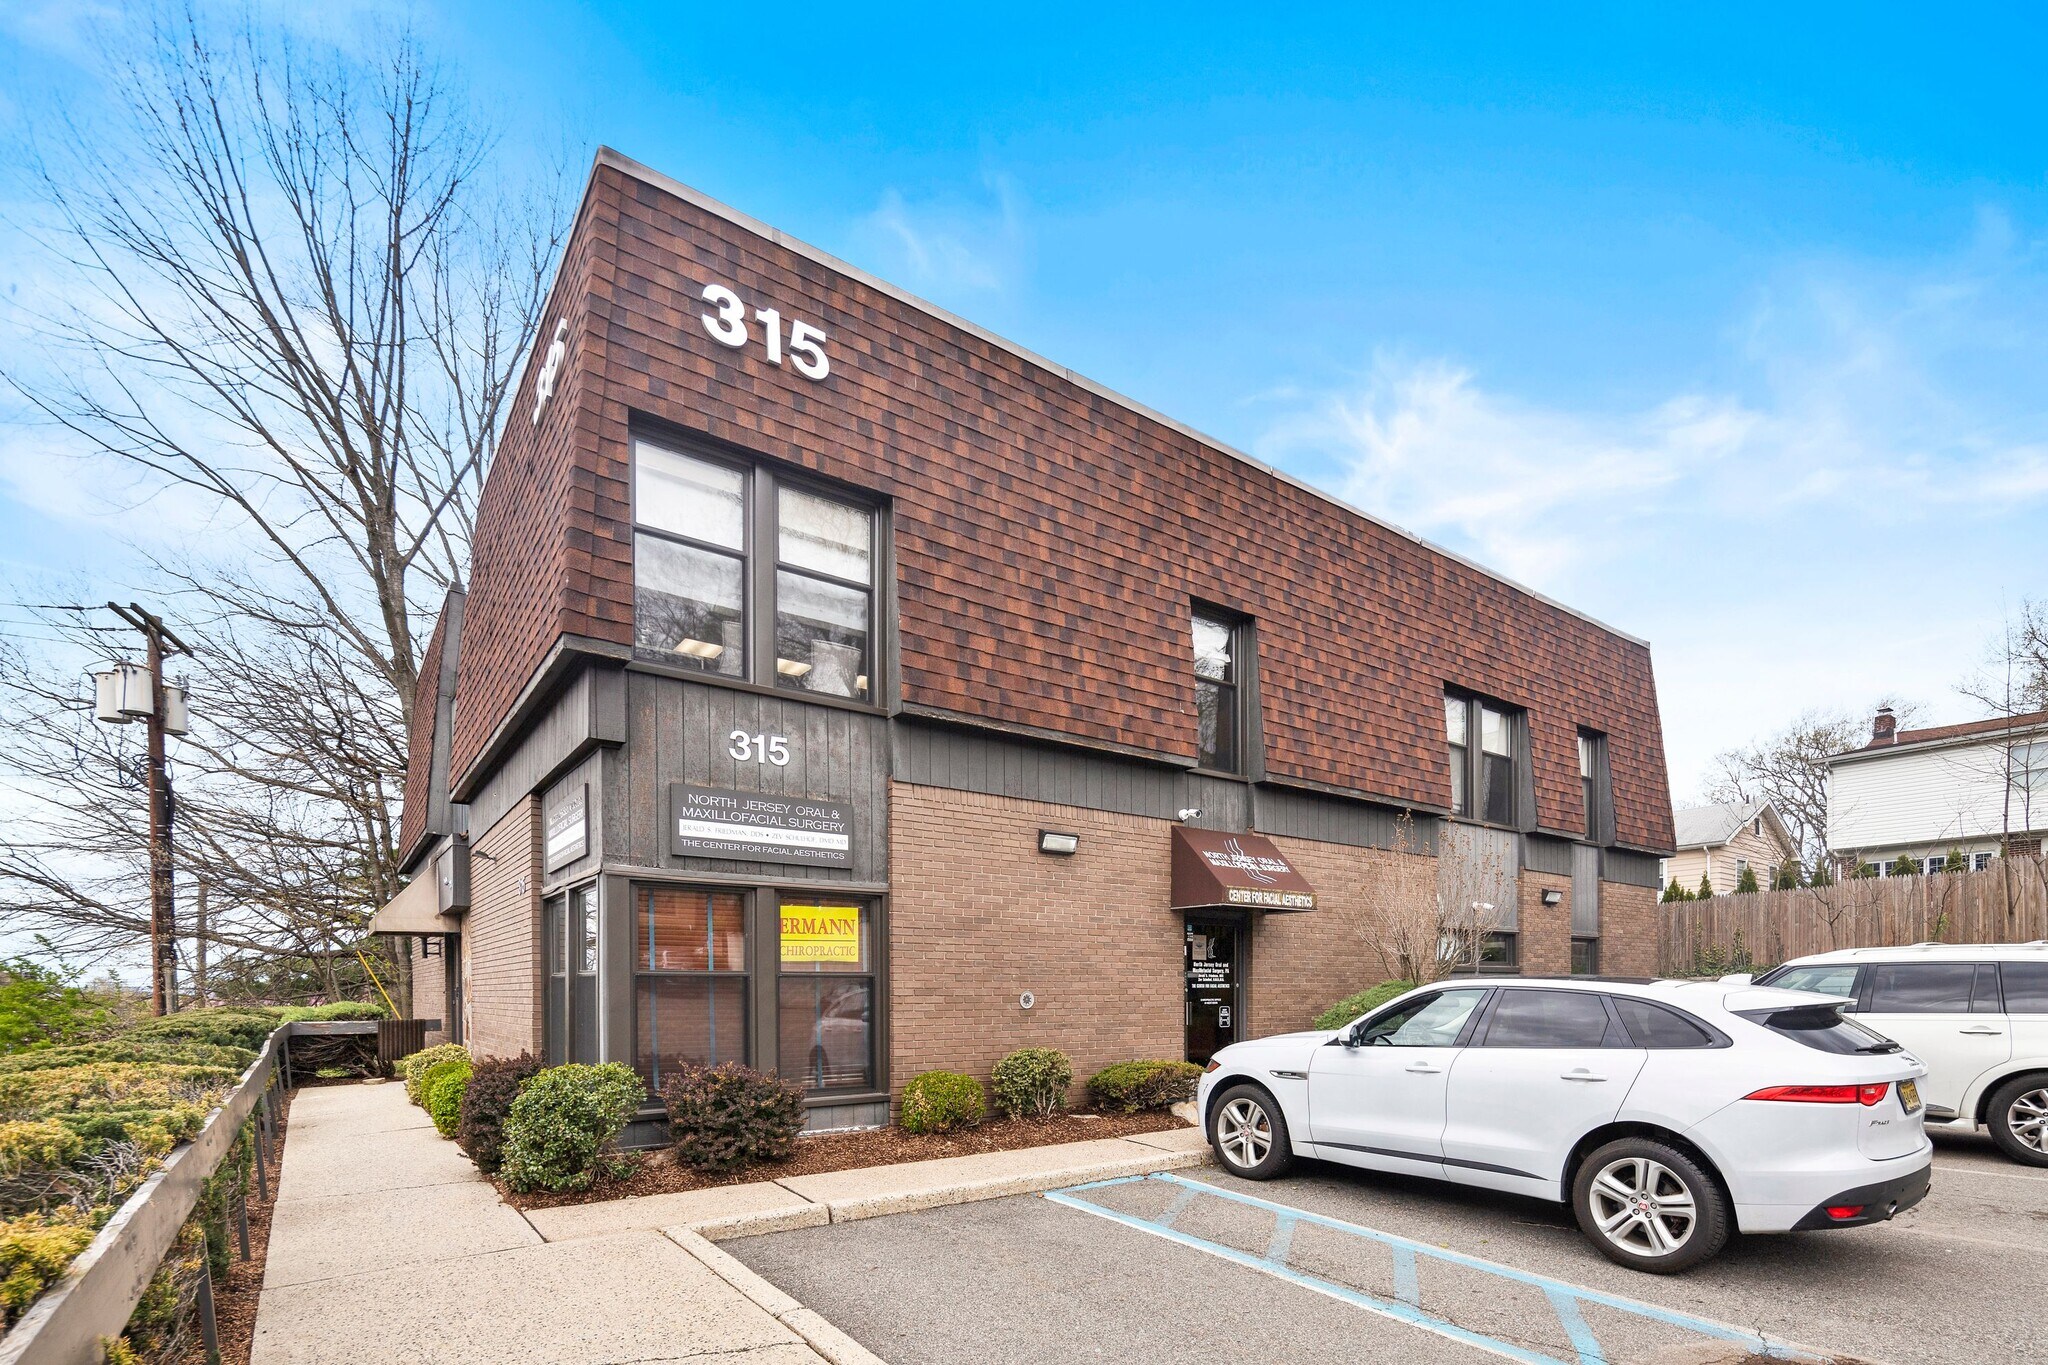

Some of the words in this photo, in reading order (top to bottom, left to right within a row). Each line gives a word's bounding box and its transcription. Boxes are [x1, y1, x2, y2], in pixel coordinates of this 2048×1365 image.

[701, 284, 831, 382] 315
[728, 730, 791, 766] 315
[688, 794, 736, 808] NORTH
[742, 800, 791, 814] JERSEY
[796, 806, 829, 818] ORAL
[831, 810, 840, 819] &
[682, 807, 786, 826] MAXILLOFACIAL
[788, 818, 844, 832] SURGERY
[681, 839, 701, 848] THE
[702, 840, 740, 850] CENTER
[742, 844, 760, 852] FOR
[762, 846, 792, 855] FACIAL
[794, 849, 844, 860] AESTHETICS
[1229, 890, 1251, 903] CENTER
[1252, 892, 1263, 903] FOR
[1264, 892, 1281, 905] FACIAL
[1282, 894, 1312, 908] AESTHETICS
[780, 918, 856, 935] ERMANN
[780, 945, 856, 956] CHIROPRACTIC
